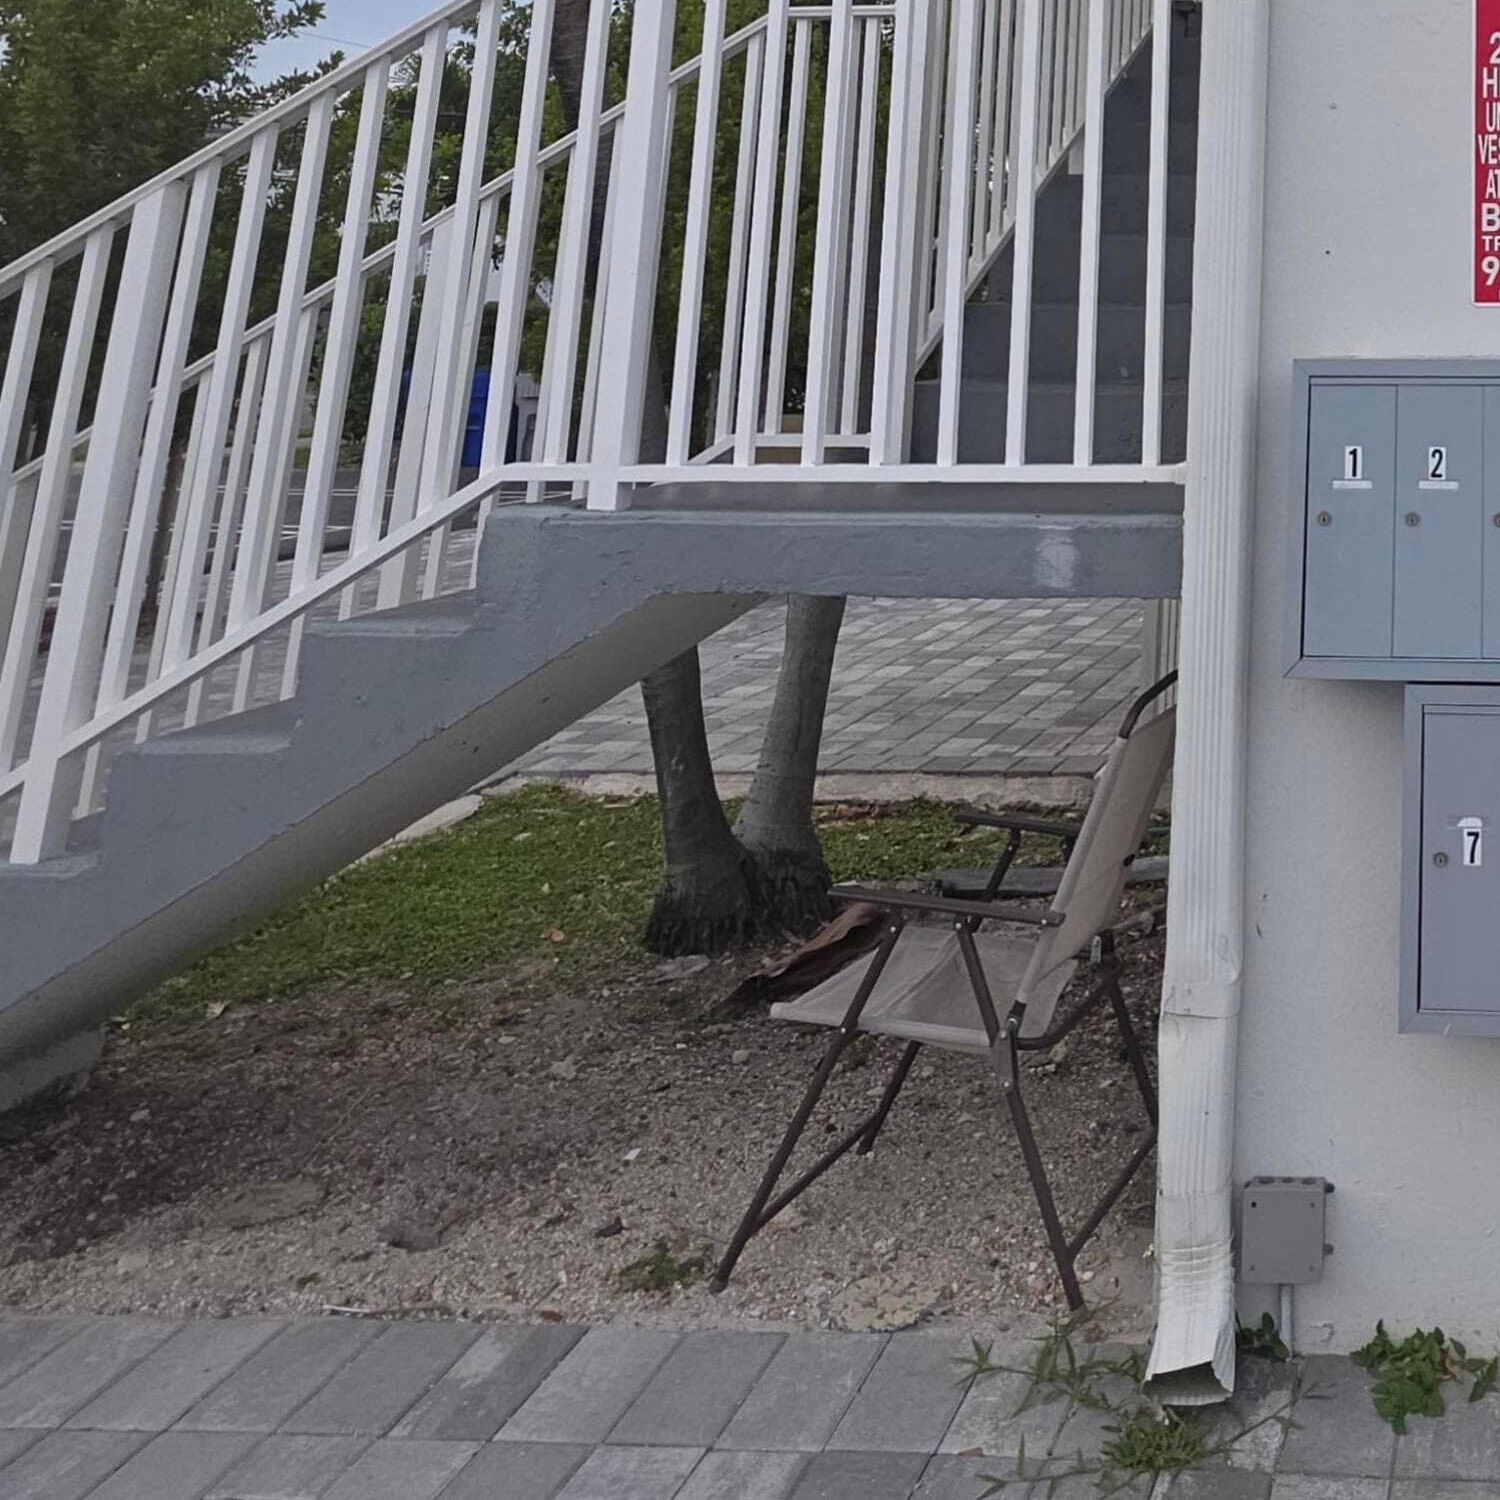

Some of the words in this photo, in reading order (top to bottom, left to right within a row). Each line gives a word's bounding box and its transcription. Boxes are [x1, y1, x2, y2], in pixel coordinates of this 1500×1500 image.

[1348, 448, 1358, 478] 1
[1431, 448, 1444, 478] 2
[1467, 831, 1479, 864] 7
